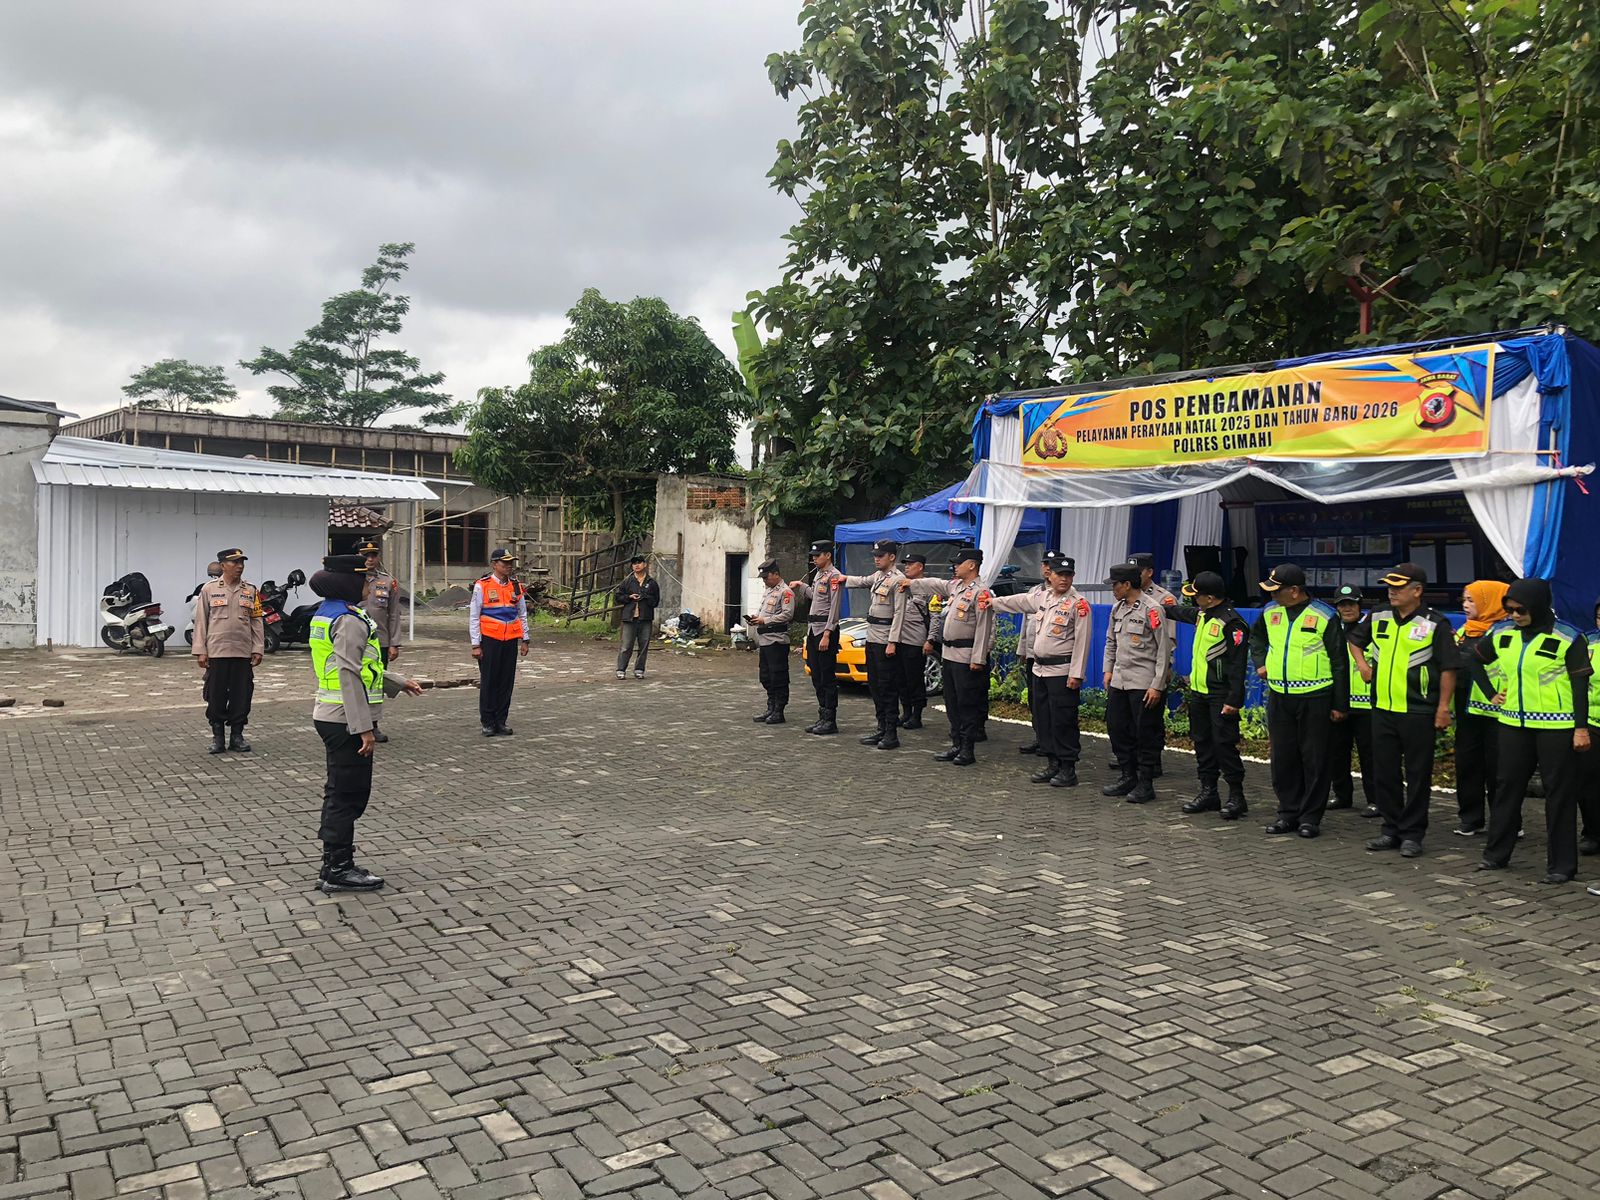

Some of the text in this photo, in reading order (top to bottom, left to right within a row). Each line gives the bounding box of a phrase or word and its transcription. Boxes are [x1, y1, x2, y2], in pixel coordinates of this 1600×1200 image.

[1130, 381, 1322, 422] POS PENGAMANAN
[1076, 401, 1399, 443] PELAYANAN PERAYAAN NATAL 2025 DAN TAHUN BARU 2026
[1173, 431, 1272, 453] POLRES CIMAHI
[1055, 609, 1070, 617] POLRI
